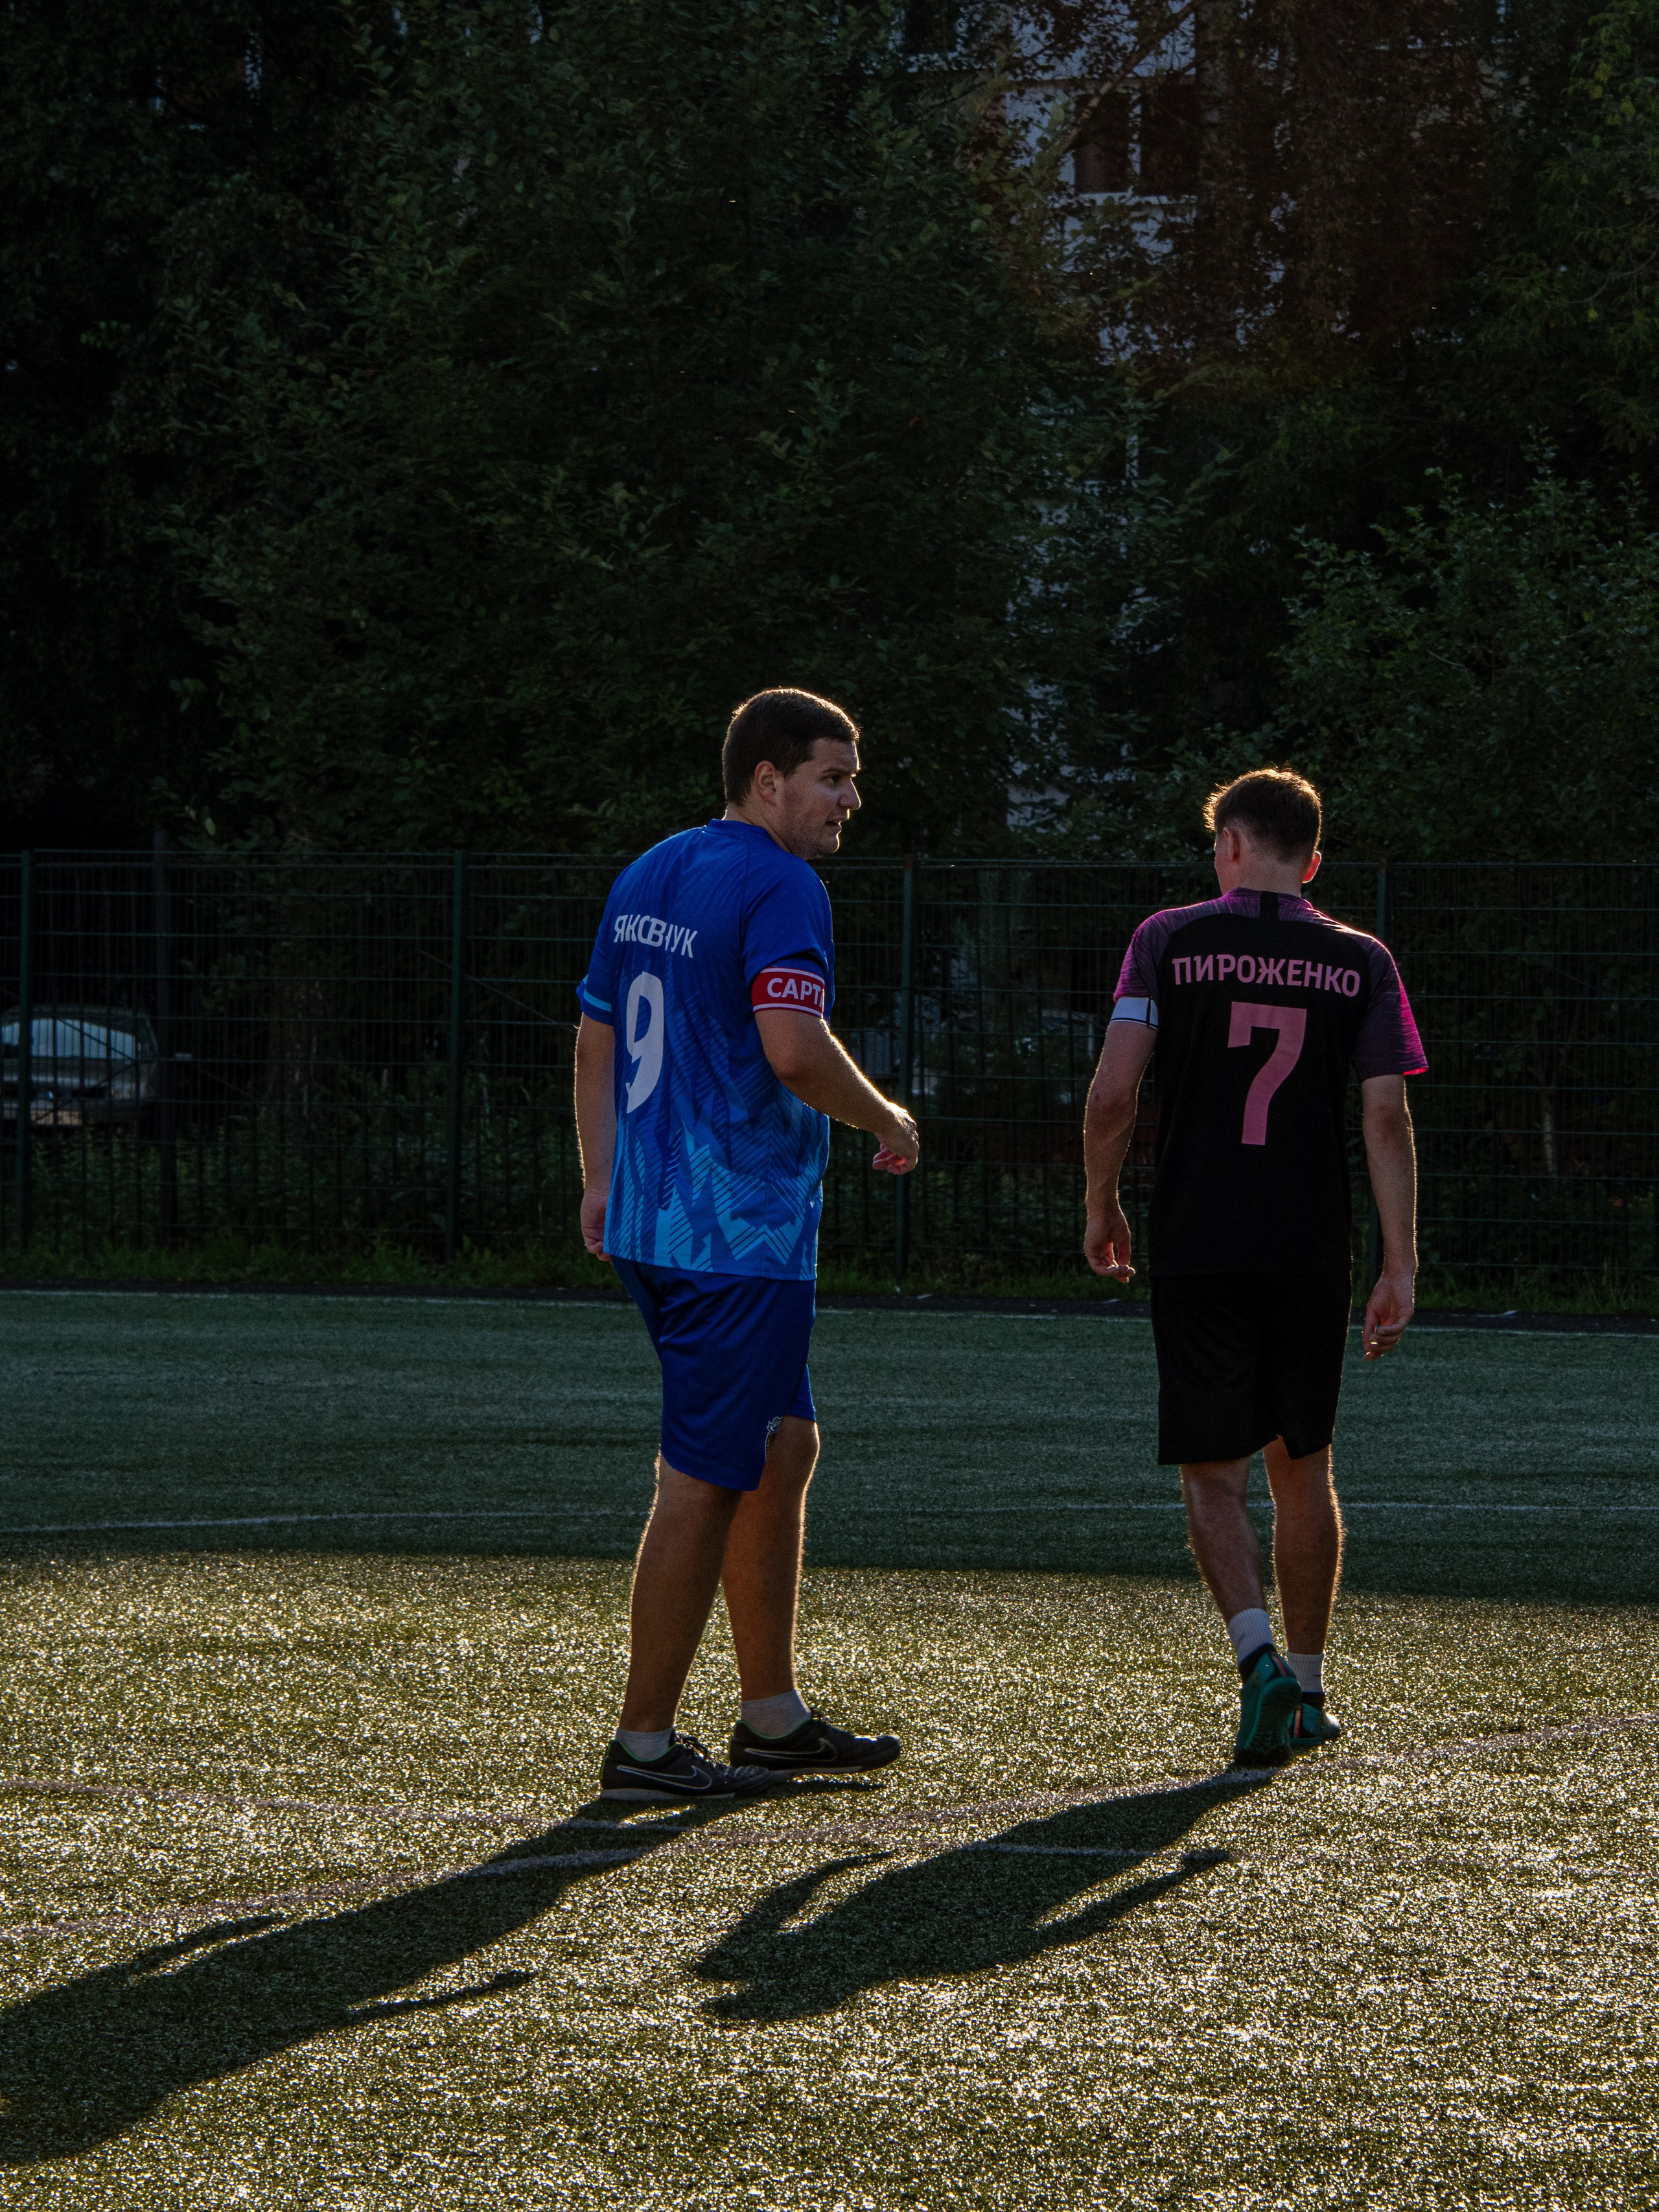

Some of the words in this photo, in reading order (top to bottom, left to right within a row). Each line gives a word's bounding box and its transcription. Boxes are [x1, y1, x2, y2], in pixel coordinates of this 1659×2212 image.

[625, 972, 664, 1114] 9
[1172, 954, 1361, 997] ПИРОЖЕНКО
[1227, 1001, 1308, 1146] 7
